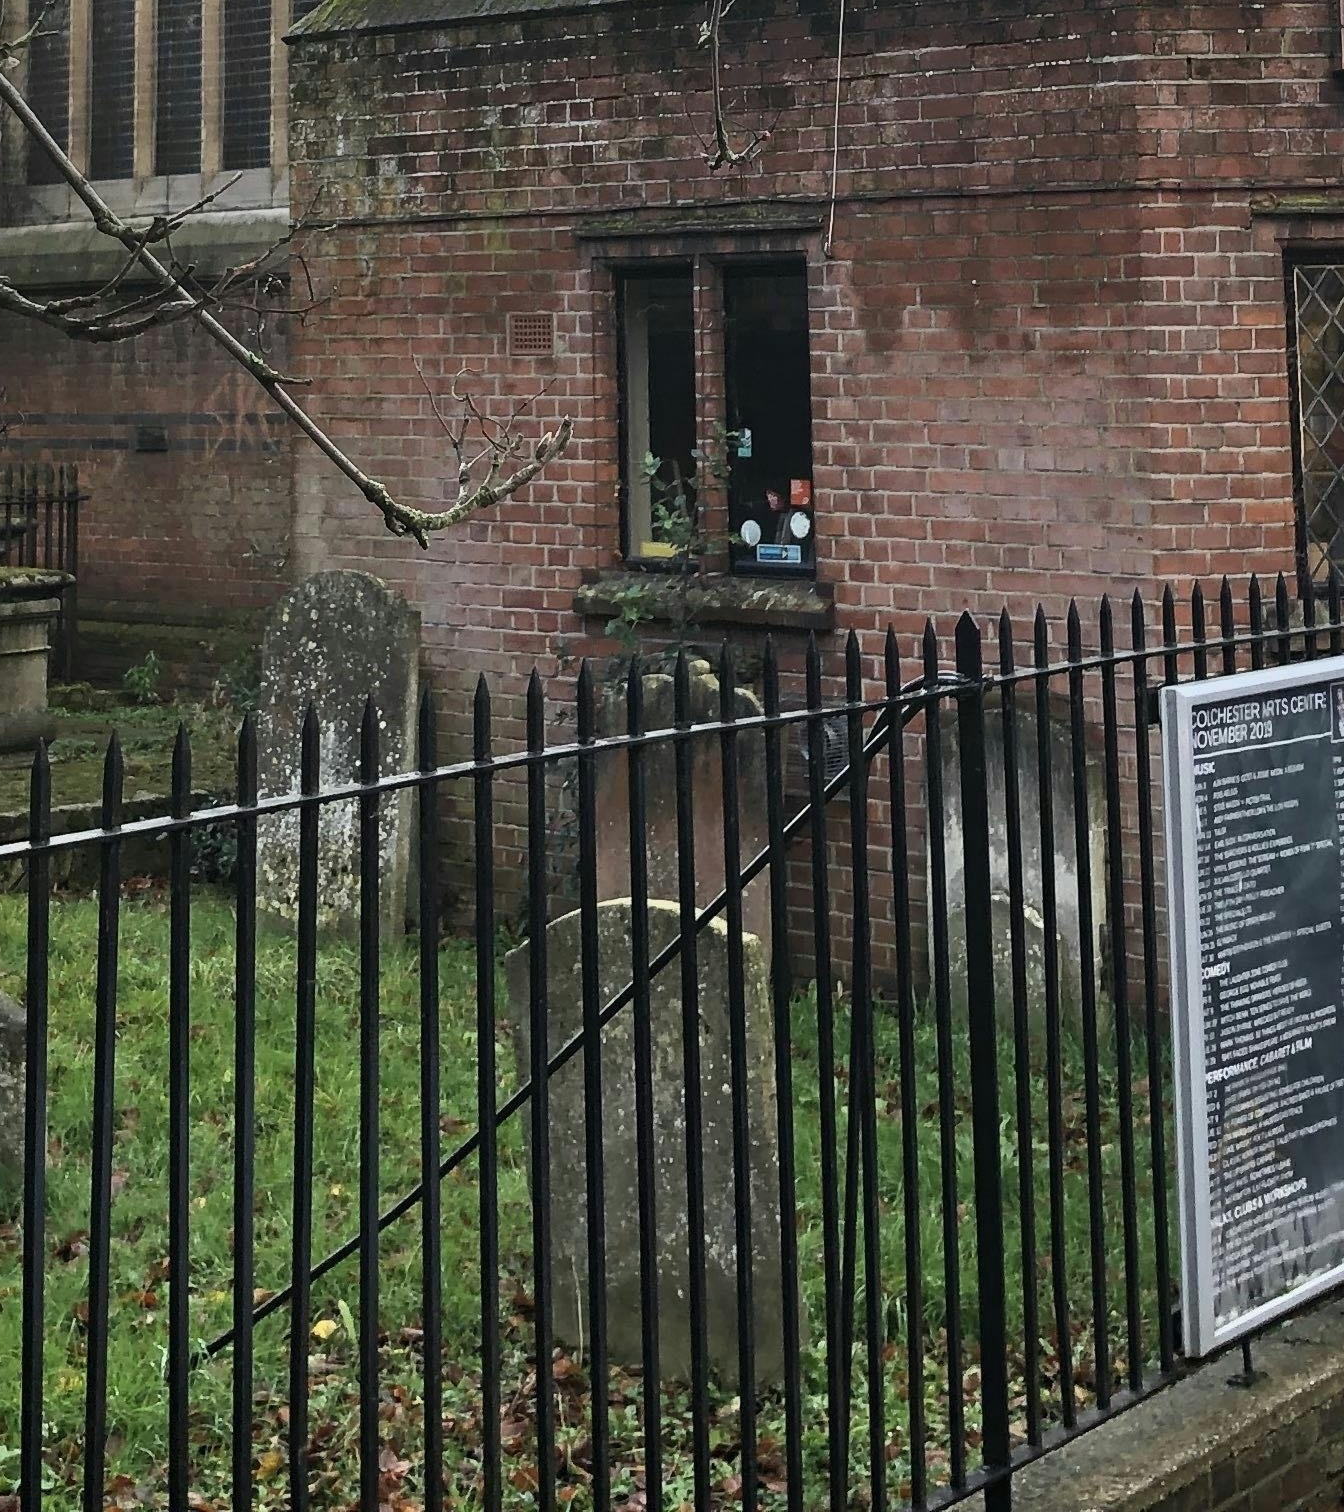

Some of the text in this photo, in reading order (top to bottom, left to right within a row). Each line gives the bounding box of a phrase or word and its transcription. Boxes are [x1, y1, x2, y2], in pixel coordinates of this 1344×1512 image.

[1192, 691, 1327, 729] COLCHESTER ARTS CENTRE
[1249, 719, 1273, 740] 2019
